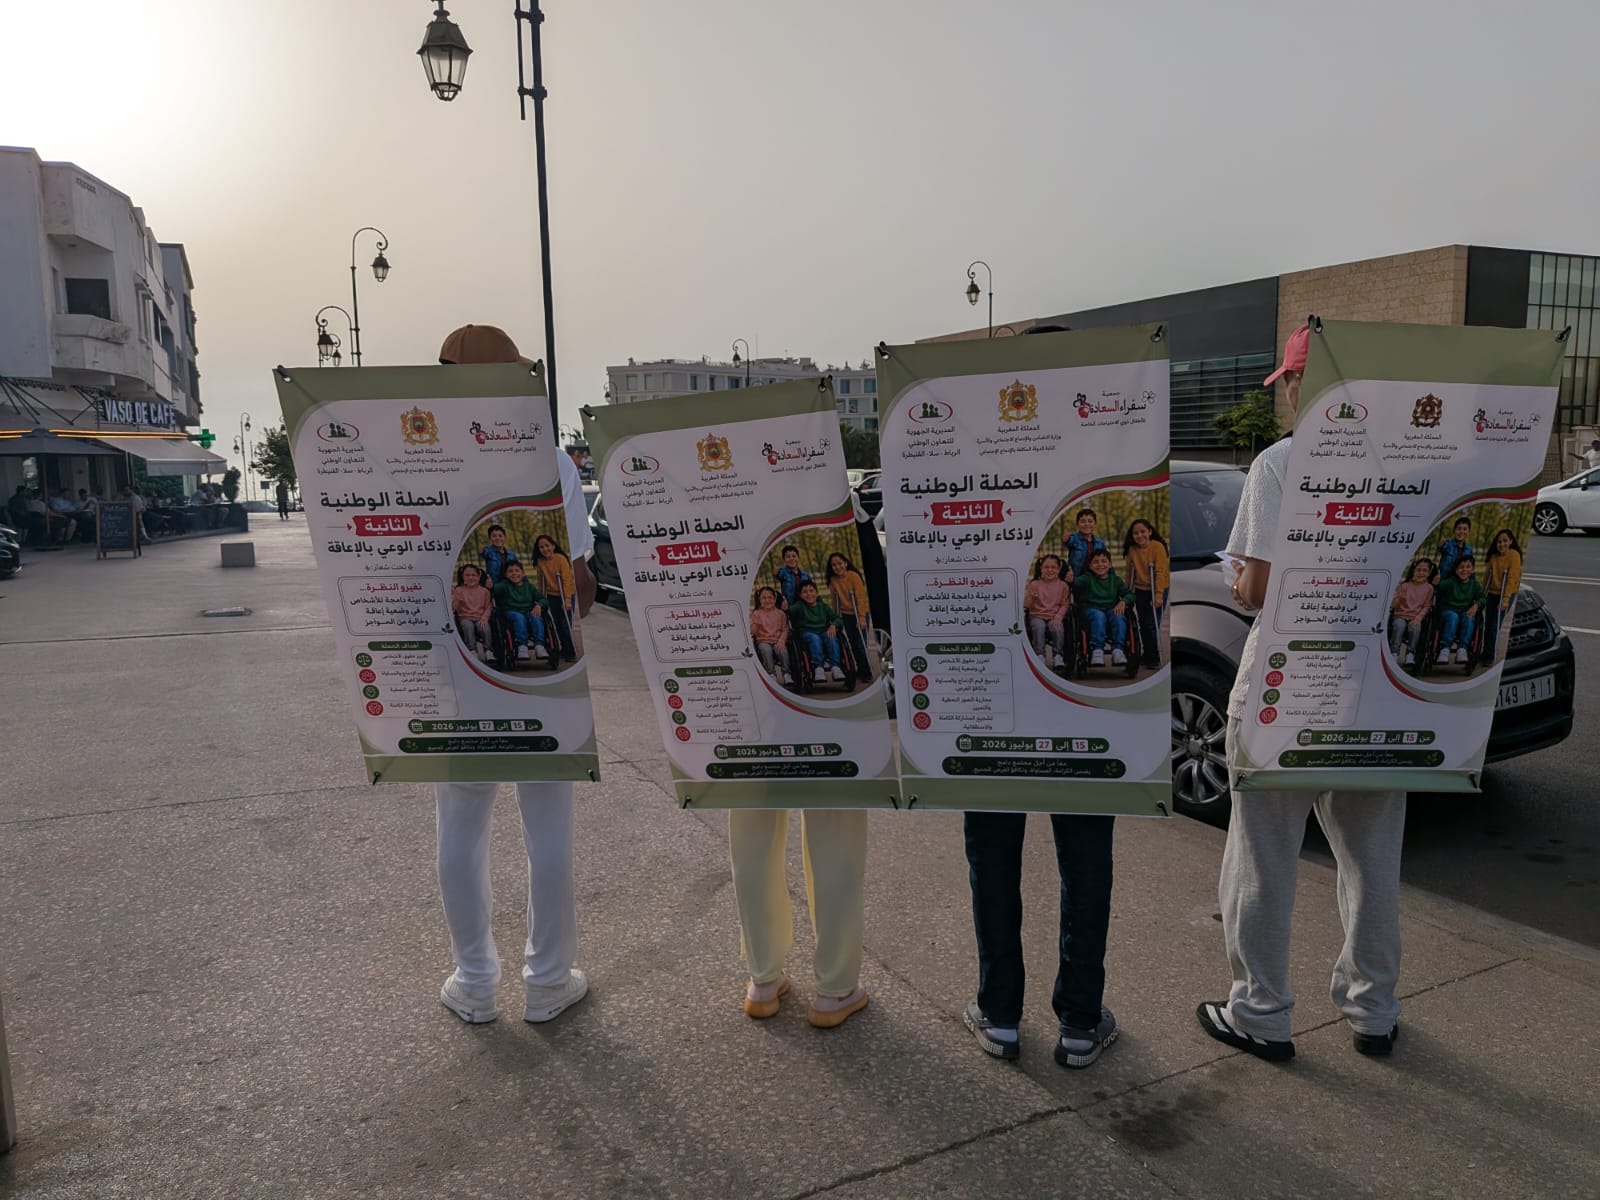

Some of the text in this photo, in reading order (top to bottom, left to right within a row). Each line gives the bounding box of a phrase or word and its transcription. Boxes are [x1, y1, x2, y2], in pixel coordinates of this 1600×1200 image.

[104, 400, 133, 424] VASO
[134, 401, 149, 425] DE
[900, 471, 1038, 500] الحملة الوطنية
[1300, 475, 1431, 499] الحملة الوطنية
[320, 490, 450, 513] الحملة الوطنية
[942, 503, 993, 524] الثانية
[1334, 505, 1384, 525] الثانية
[364, 517, 413, 536] الثانية
[626, 514, 745, 544] الحملة الوطنية
[899, 527, 1033, 550] لإذكاء الوعي بالإعاقة
[1288, 528, 1415, 550] لإذكاء الوعي بالإعاقة
[327, 540, 452, 559] لإذكاء الوعي بالإعاقة
[667, 544, 711, 564] الثانية
[1494, 685, 1519, 709] 149
[431, 722, 455, 730] 2026
[481, 722, 492, 730] 27
[981, 739, 1104, 752] من 15 إلى 27 يوليوز 2026
[1320, 734, 1345, 743] 2026
[1344, 733, 1369, 744] يوليوز
[1372, 733, 1384, 742] 27
[1387, 732, 1401, 743] إلى
[1405, 733, 1415, 741] 15
[735, 748, 757, 756] 2026
[782, 747, 792, 755] 27
[812, 746, 823, 754] 15
